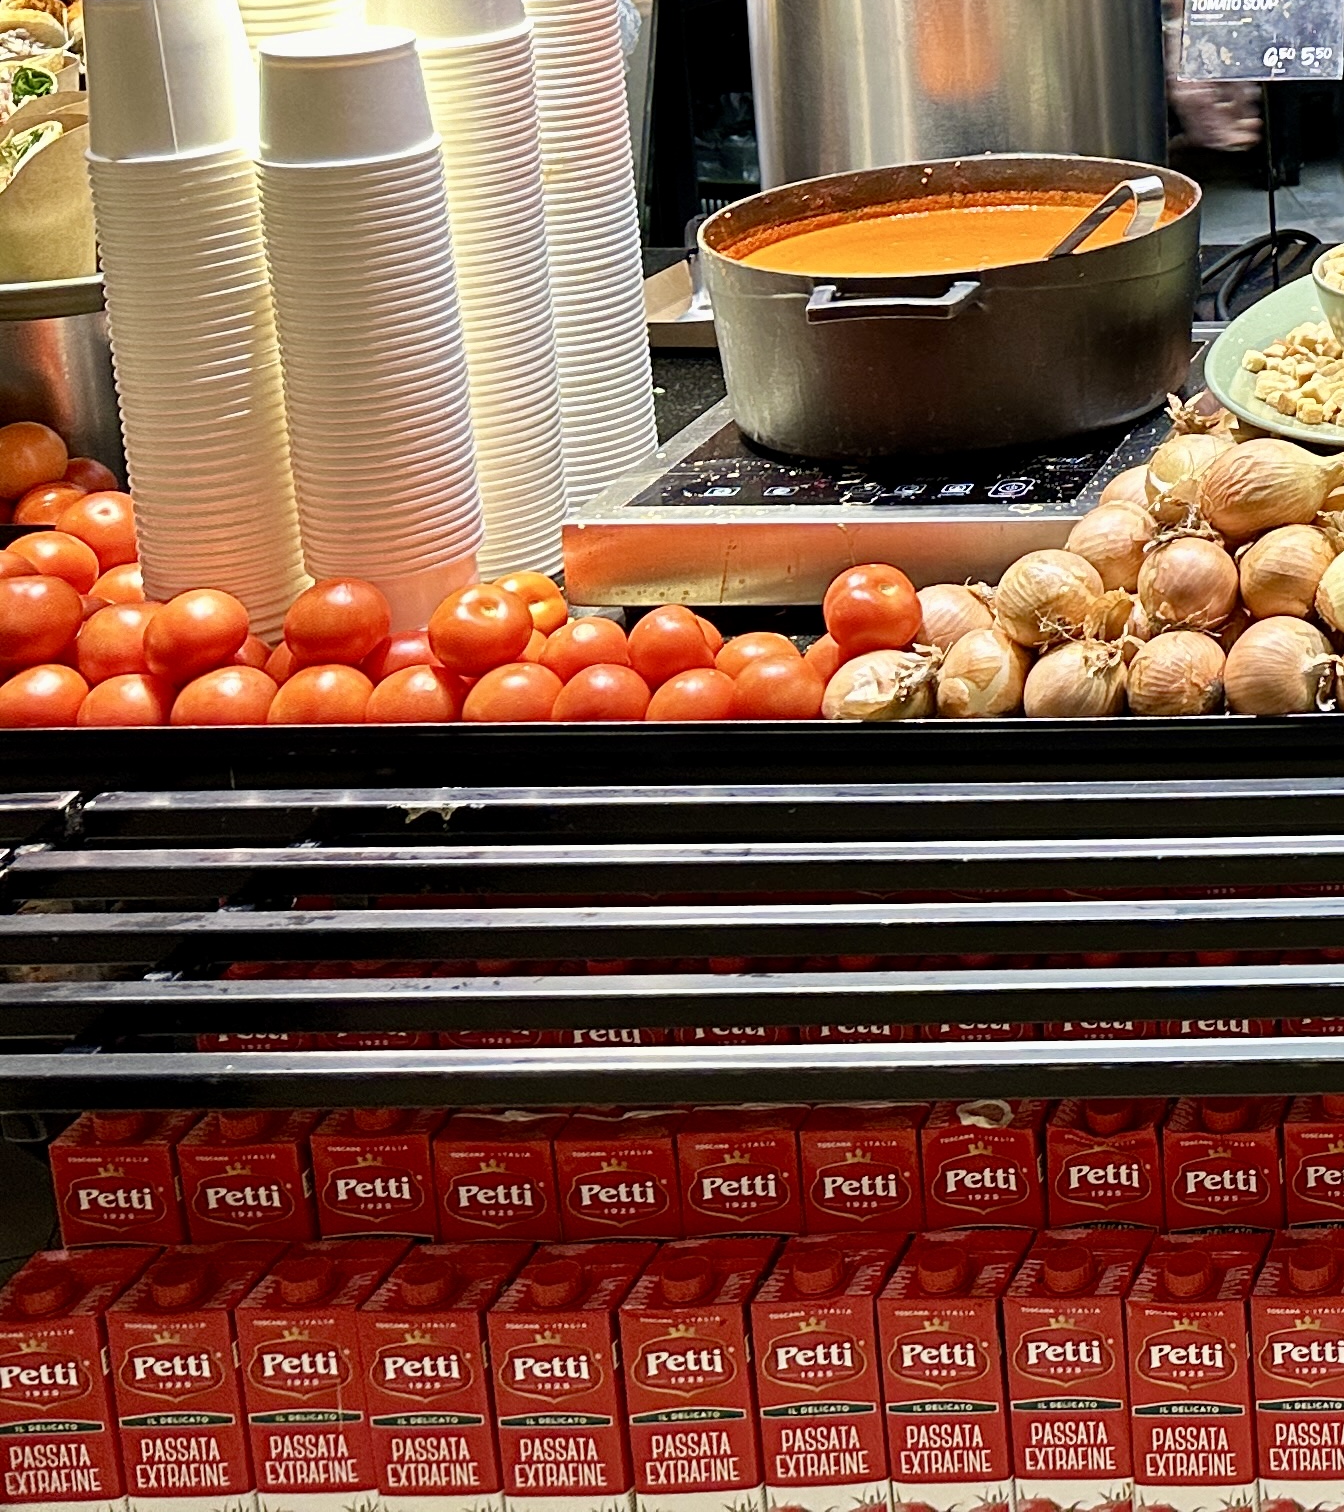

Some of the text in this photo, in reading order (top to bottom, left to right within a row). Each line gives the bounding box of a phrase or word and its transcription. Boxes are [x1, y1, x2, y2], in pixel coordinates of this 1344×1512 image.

[703, 1174, 776, 1199] Petti
[824, 1174, 896, 1198] Petti
[947, 1168, 1017, 1192] Petti
[1070, 1164, 1138, 1188] Petti
[1187, 1170, 1256, 1193] Petti
[79, 1189, 152, 1209] Petti
[207, 1186, 280, 1208] Petti
[337, 1177, 410, 1200] Petti
[459, 1184, 532, 1206] Petti
[581, 1182, 654, 1205] Petti
[647, 1350, 723, 1376] Petti
[777, 1344, 852, 1370] Petti
[902, 1344, 975, 1367] Petti
[1026, 1341, 1101, 1364] Petti
[1150, 1344, 1223, 1368] Petti
[134, 1354, 210, 1379] Petti
[263, 1353, 338, 1376] Petti
[384, 1357, 460, 1380] Petti
[514, 1357, 589, 1380] Petti
[160, 1416, 209, 1425] DELICATO
[652, 1432, 731, 1458] PASSATA
[782, 1426, 859, 1452] PASSATA
[907, 1425, 983, 1448] PASSATA
[1031, 1422, 1107, 1445] PASSATA
[1153, 1427, 1228, 1451] PASSATA
[10, 1444, 90, 1469] PASSATA
[141, 1438, 220, 1462] PASSATA
[270, 1435, 348, 1458] PASSATA
[392, 1438, 470, 1461] PASSATA
[520, 1438, 597, 1461] PASSATA
[776, 1451, 869, 1478] EXTRAFINE
[901, 1450, 992, 1474] EXTRAFINE
[1025, 1447, 1116, 1470] EXTRAFINE
[1146, 1453, 1236, 1476] EXTRAFINE
[5, 1469, 101, 1494] EXTRAFINE
[137, 1463, 230, 1488] EXTRAFINE
[266, 1459, 358, 1484] EXTRAFINE
[387, 1463, 480, 1486] EXTRAFINE
[515, 1463, 607, 1487] EXTRAFINE
[646, 1458, 740, 1485] EXTRAFINE
